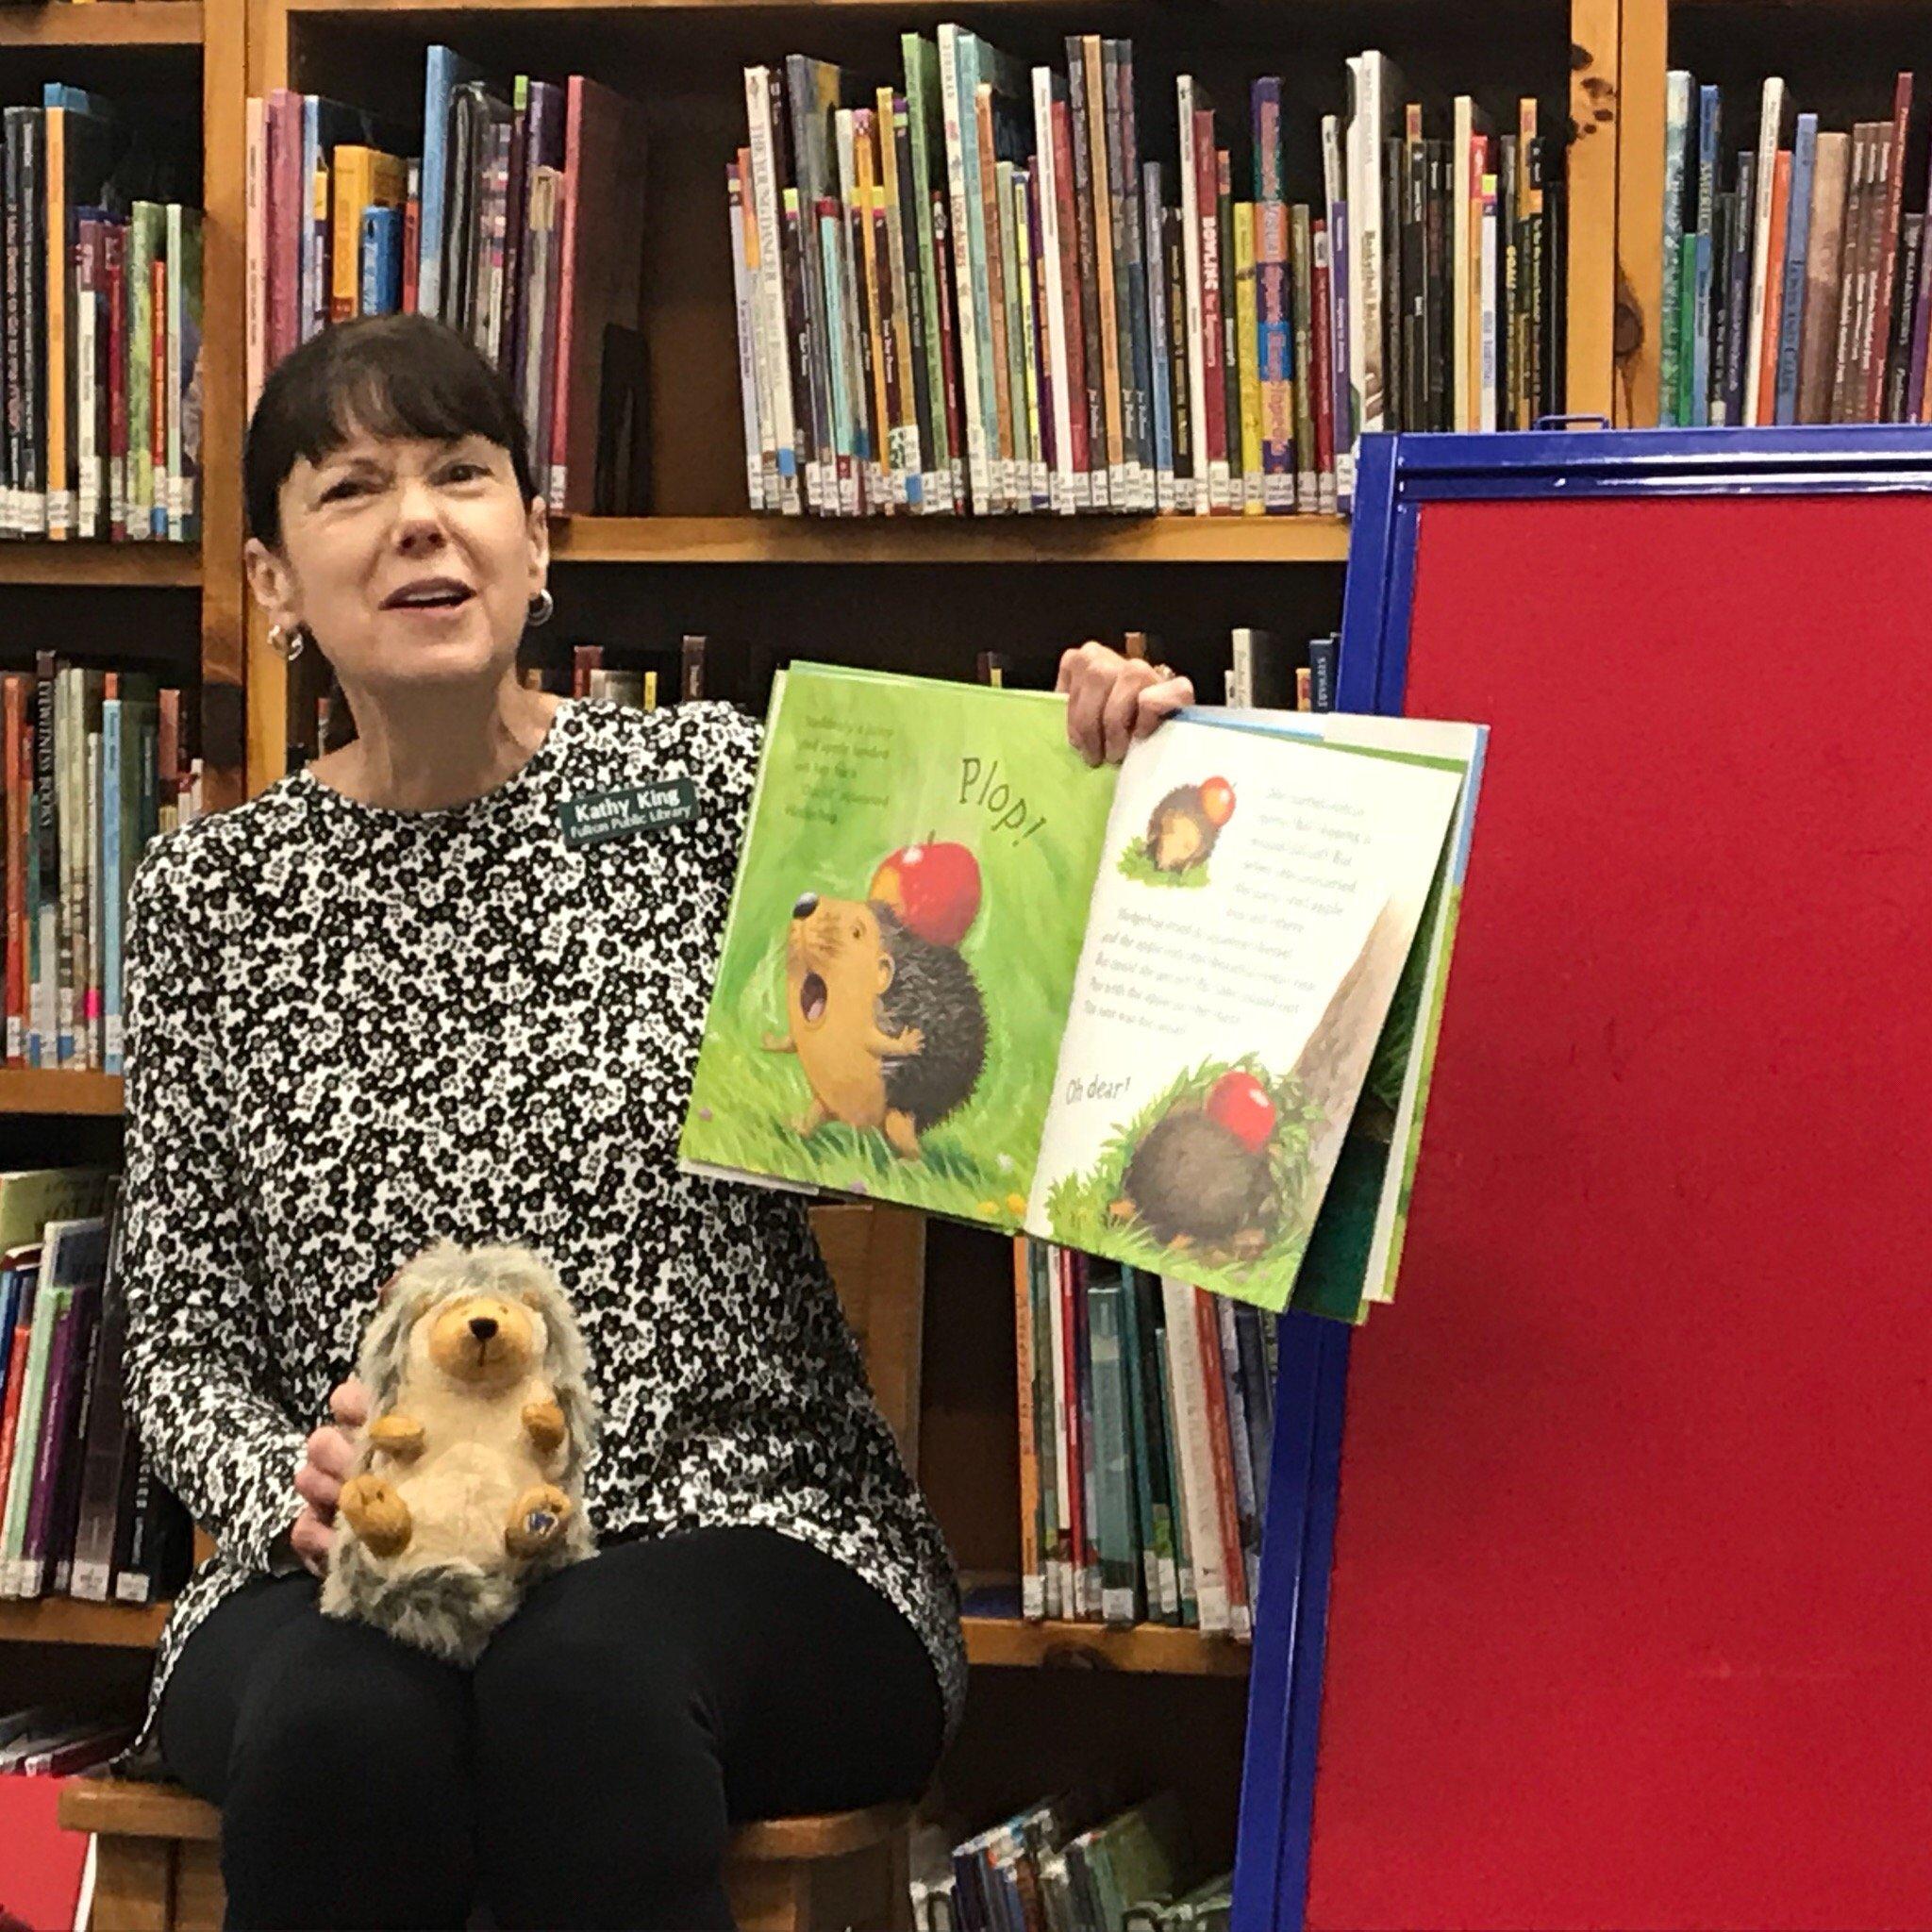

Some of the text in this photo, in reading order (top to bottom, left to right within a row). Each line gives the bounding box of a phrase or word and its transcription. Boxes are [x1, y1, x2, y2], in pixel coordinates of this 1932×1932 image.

[575, 789, 680, 823] Kathy King
[959, 758, 1047, 847] Plop!
[1066, 1074, 1131, 1106] Oh dear!
